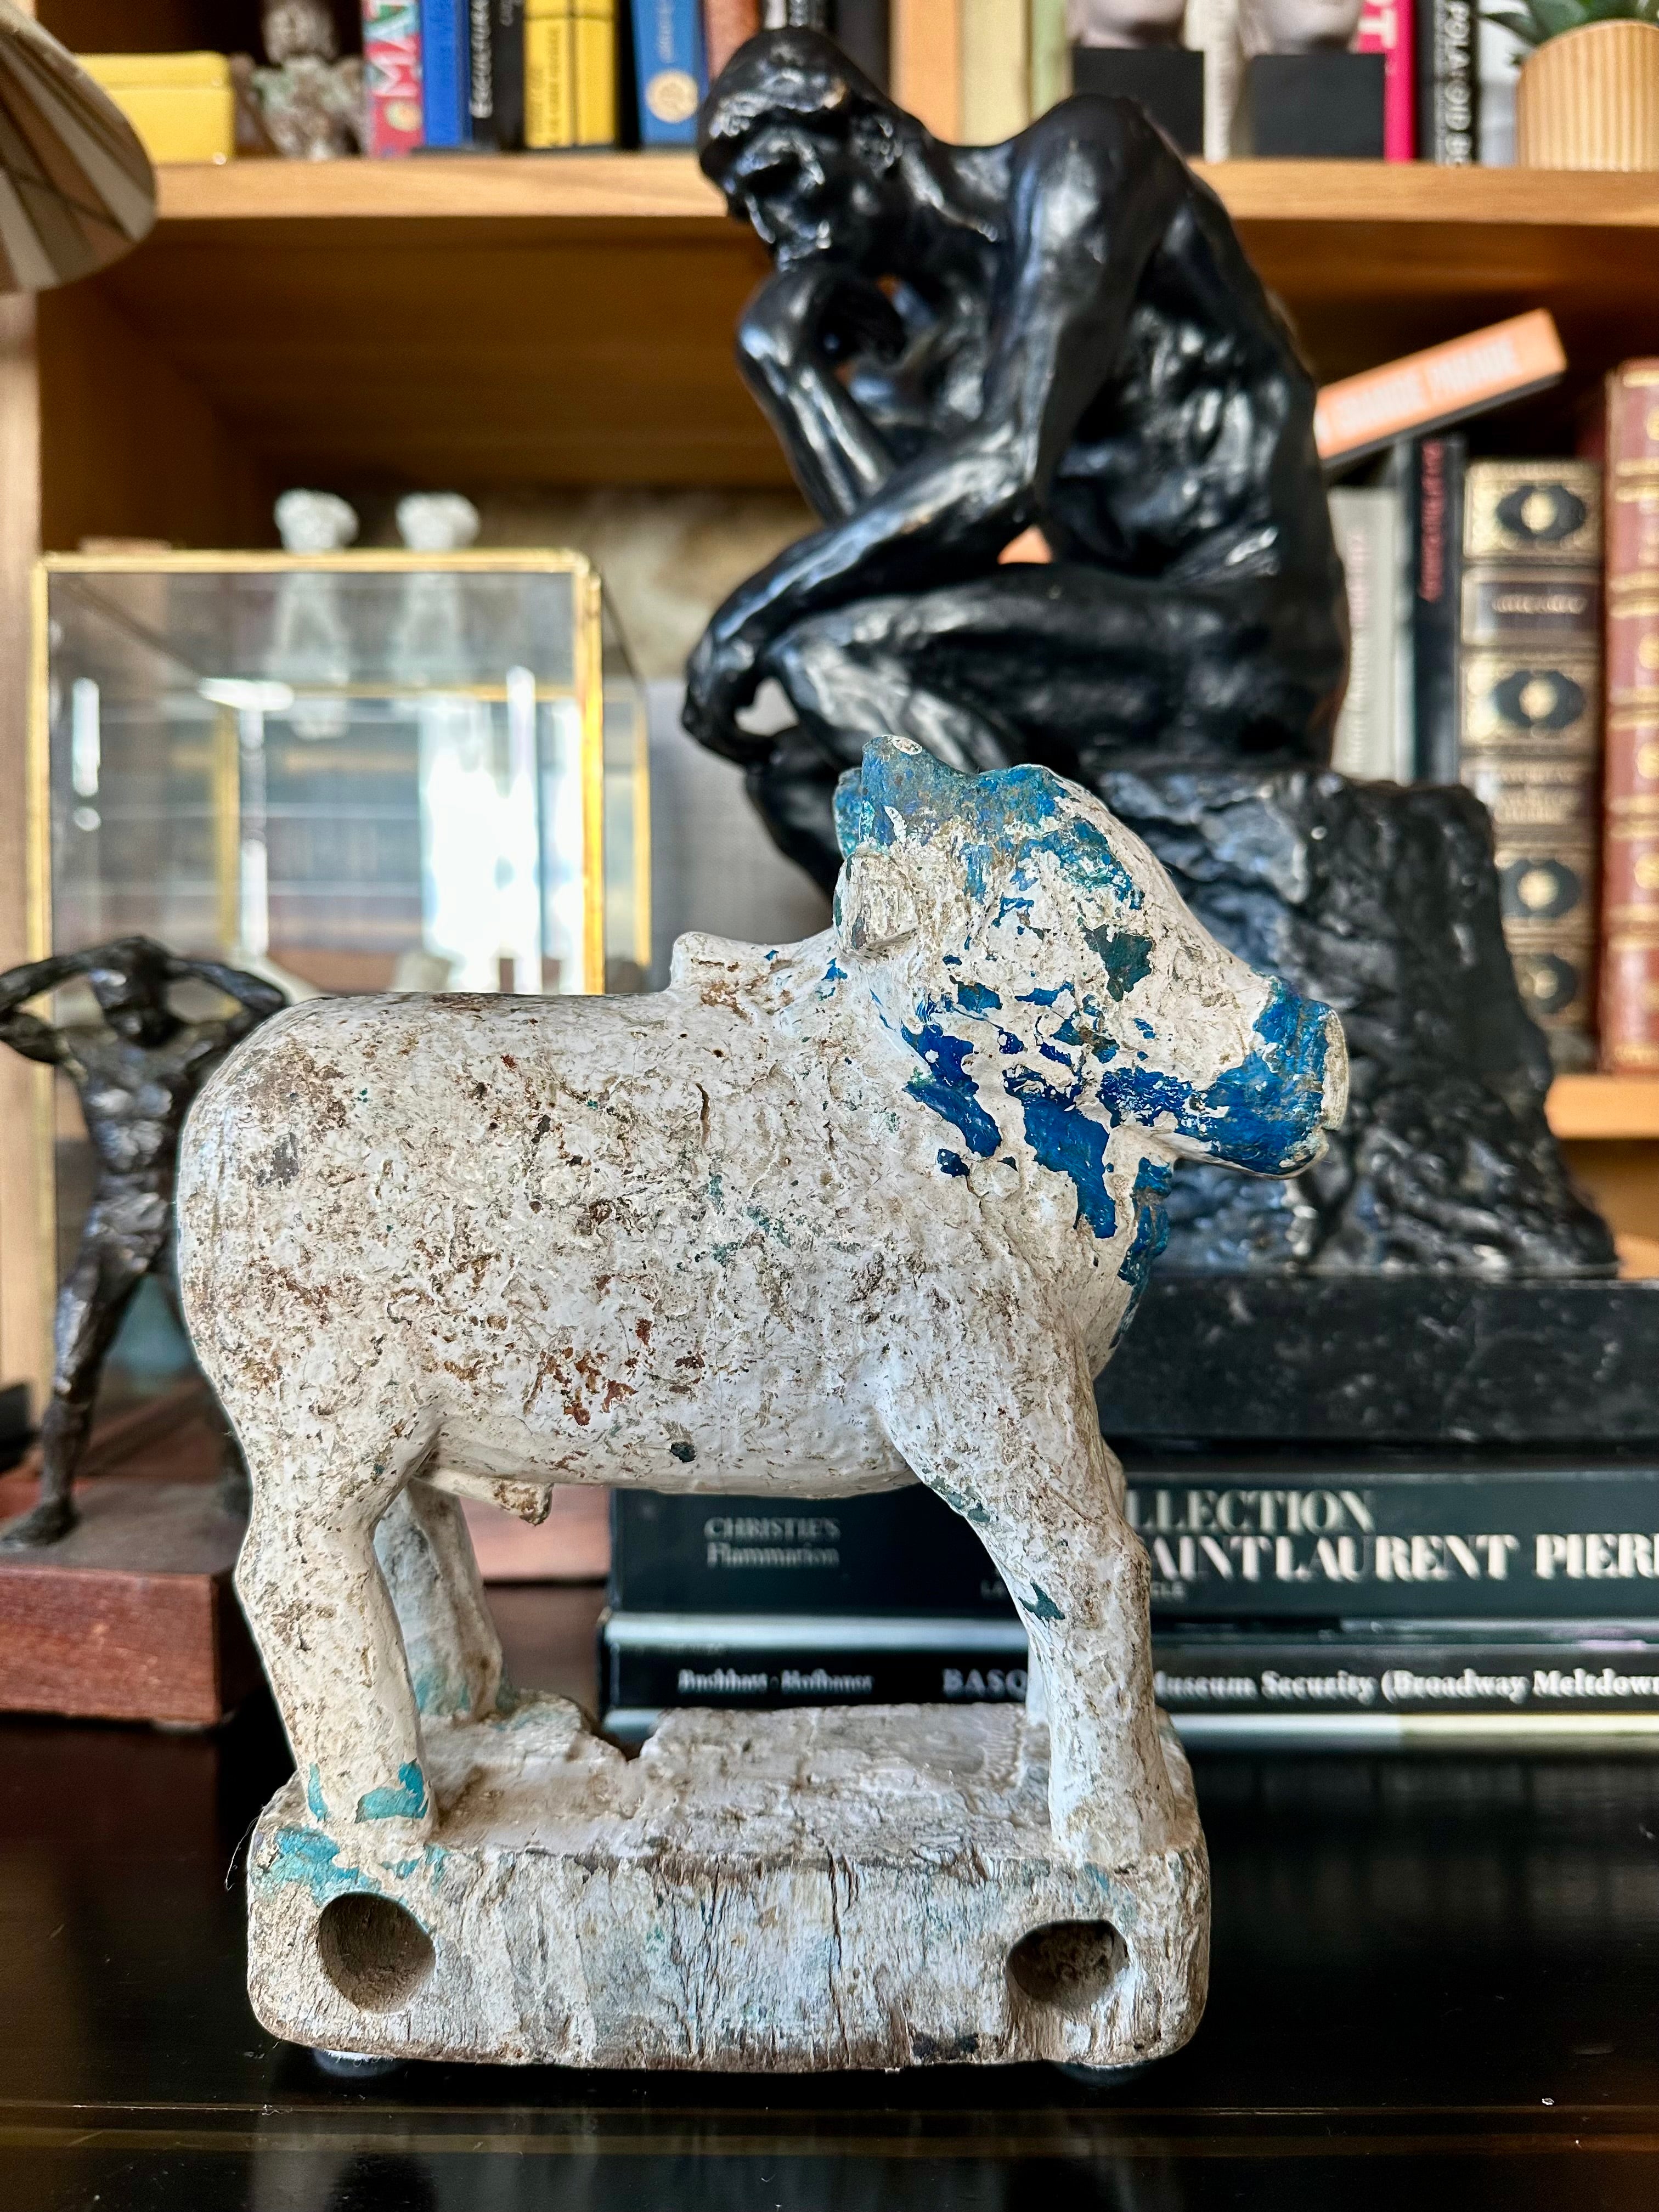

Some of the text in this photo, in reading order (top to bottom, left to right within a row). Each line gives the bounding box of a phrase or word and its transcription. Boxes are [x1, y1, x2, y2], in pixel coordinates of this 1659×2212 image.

[707, 1542, 839, 1568] Flammarion
[1534, 1533, 1659, 1580] PIER
[1262, 1670, 1377, 1705] Security
[1381, 1669, 1530, 1705] (Broadway
